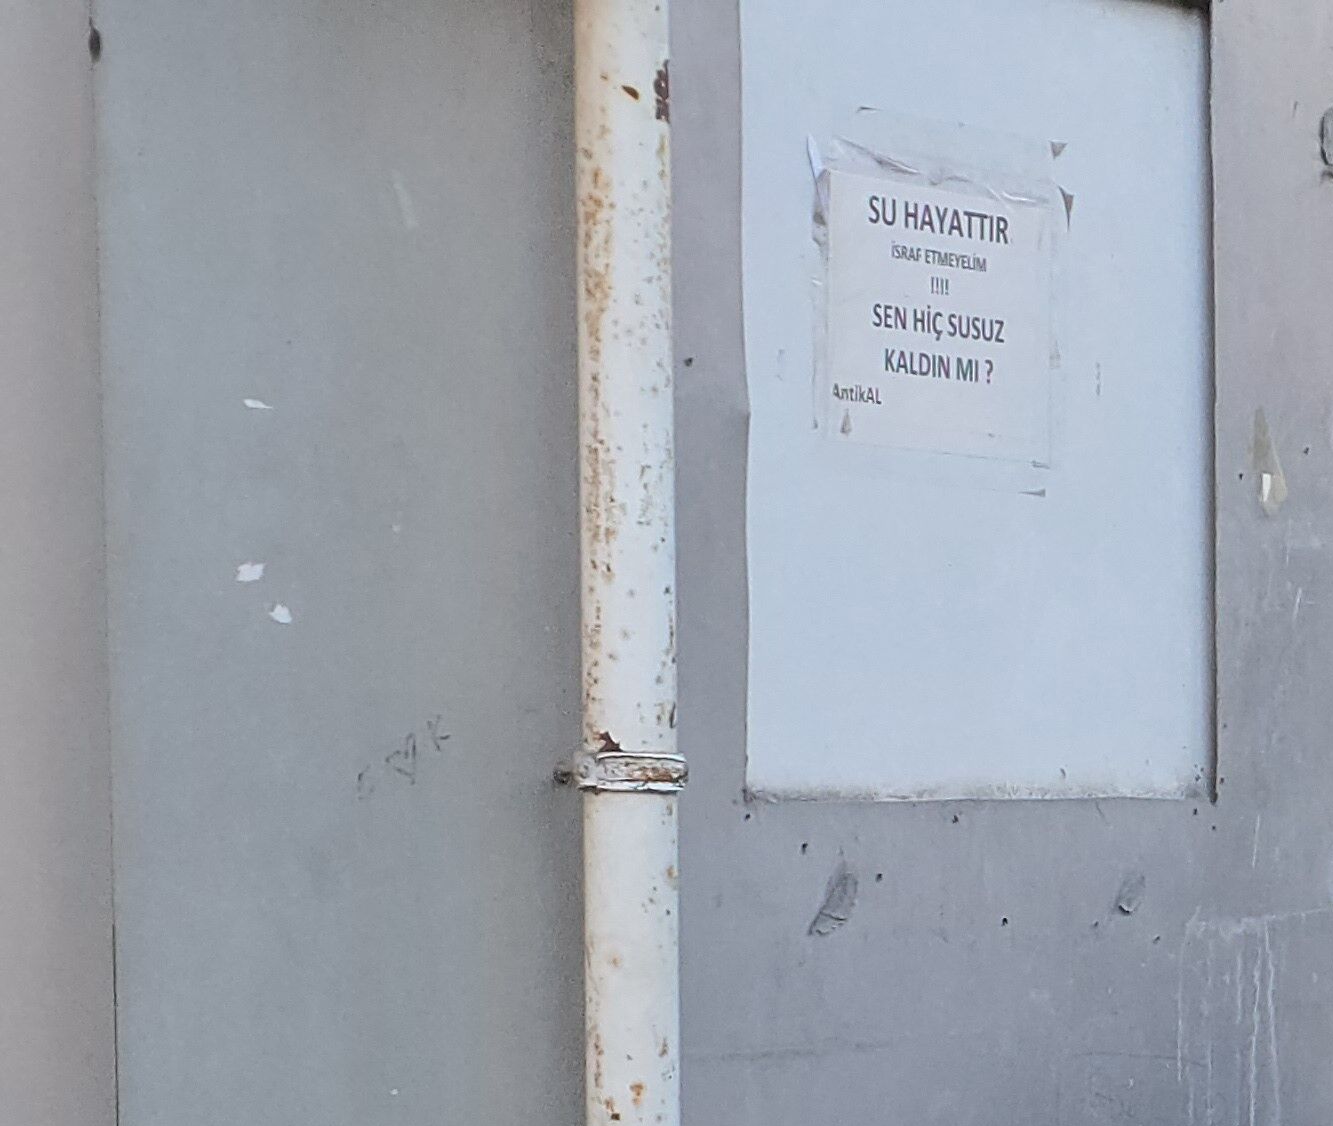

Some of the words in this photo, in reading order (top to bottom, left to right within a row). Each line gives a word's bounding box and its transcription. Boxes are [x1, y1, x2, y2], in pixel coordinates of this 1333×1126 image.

[868, 195, 896, 227] SU
[904, 200, 1009, 244] HAYATTIR
[891, 239, 922, 262] İSRAF
[924, 247, 987, 272] ETMEYELİM
[872, 303, 907, 330] SEN
[913, 304, 944, 342] HİÇ
[948, 313, 1005, 344] SUSUZ
[884, 347, 951, 380] KALDIN
[956, 357, 979, 383] MI
[985, 359, 994, 384] ?
